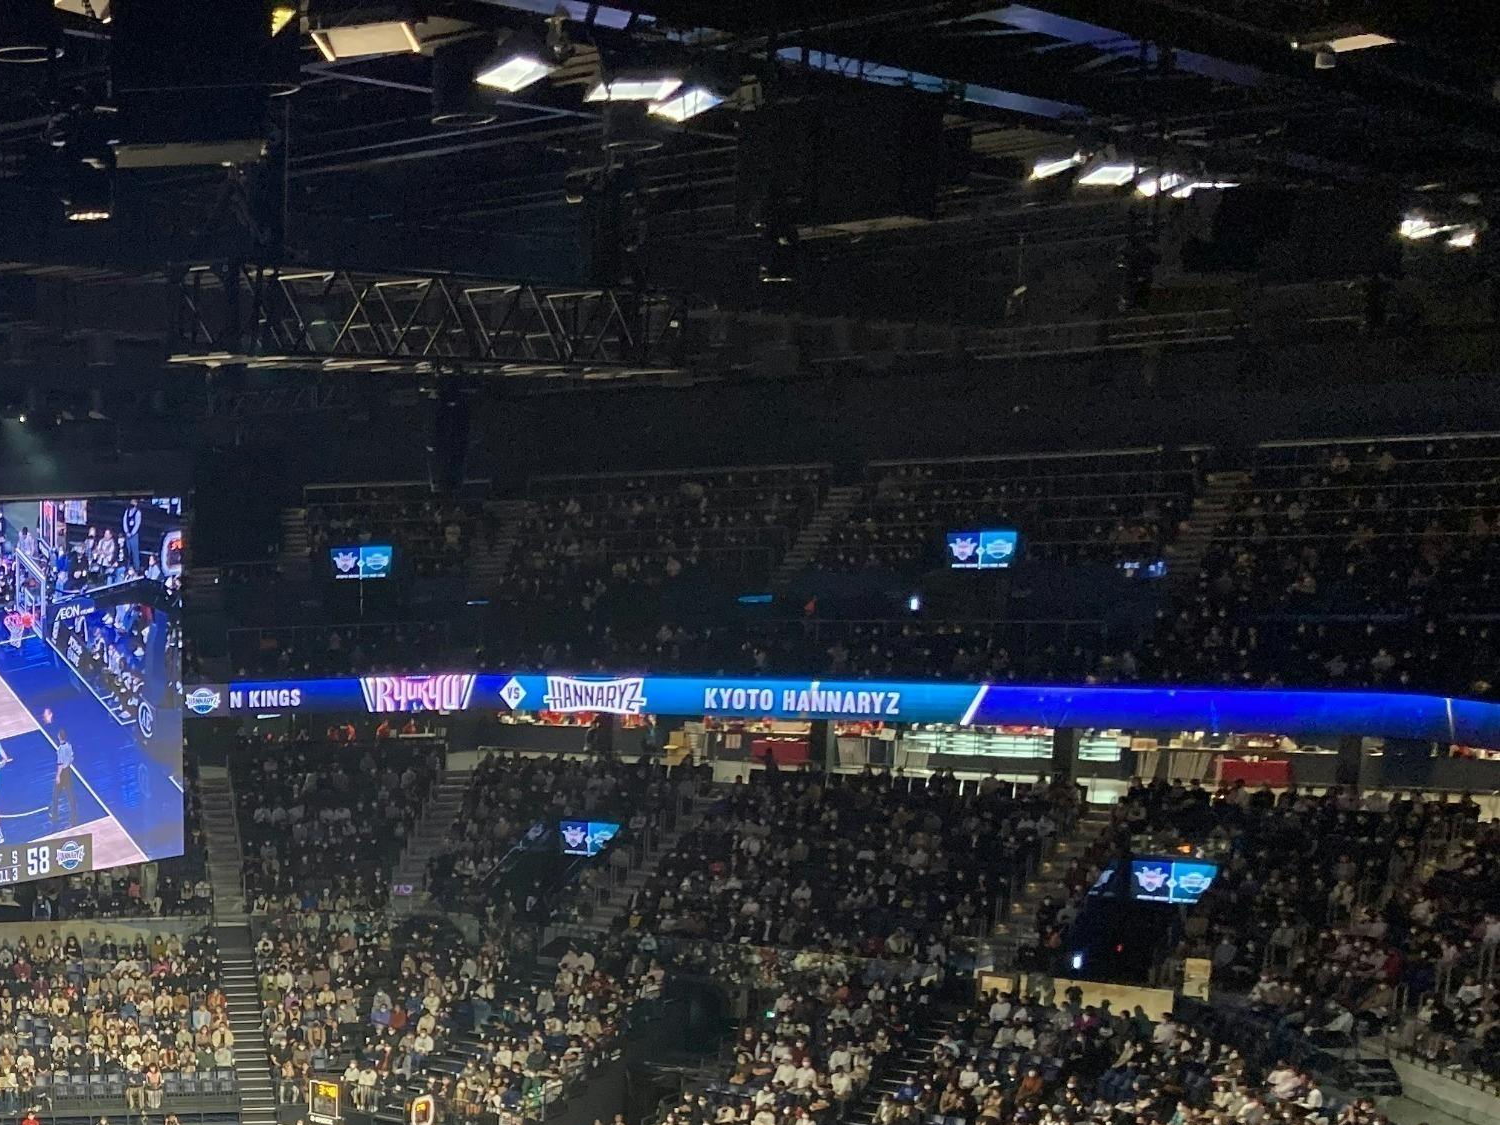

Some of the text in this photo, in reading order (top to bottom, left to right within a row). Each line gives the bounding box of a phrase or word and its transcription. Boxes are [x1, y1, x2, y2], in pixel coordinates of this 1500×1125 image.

[249, 688, 300, 708] KINGS
[507, 687, 520, 700] VS
[546, 680, 644, 712] HANNARYZ
[704, 687, 900, 715] KYOTO HANNARYZ
[27, 846, 50, 876] 58
